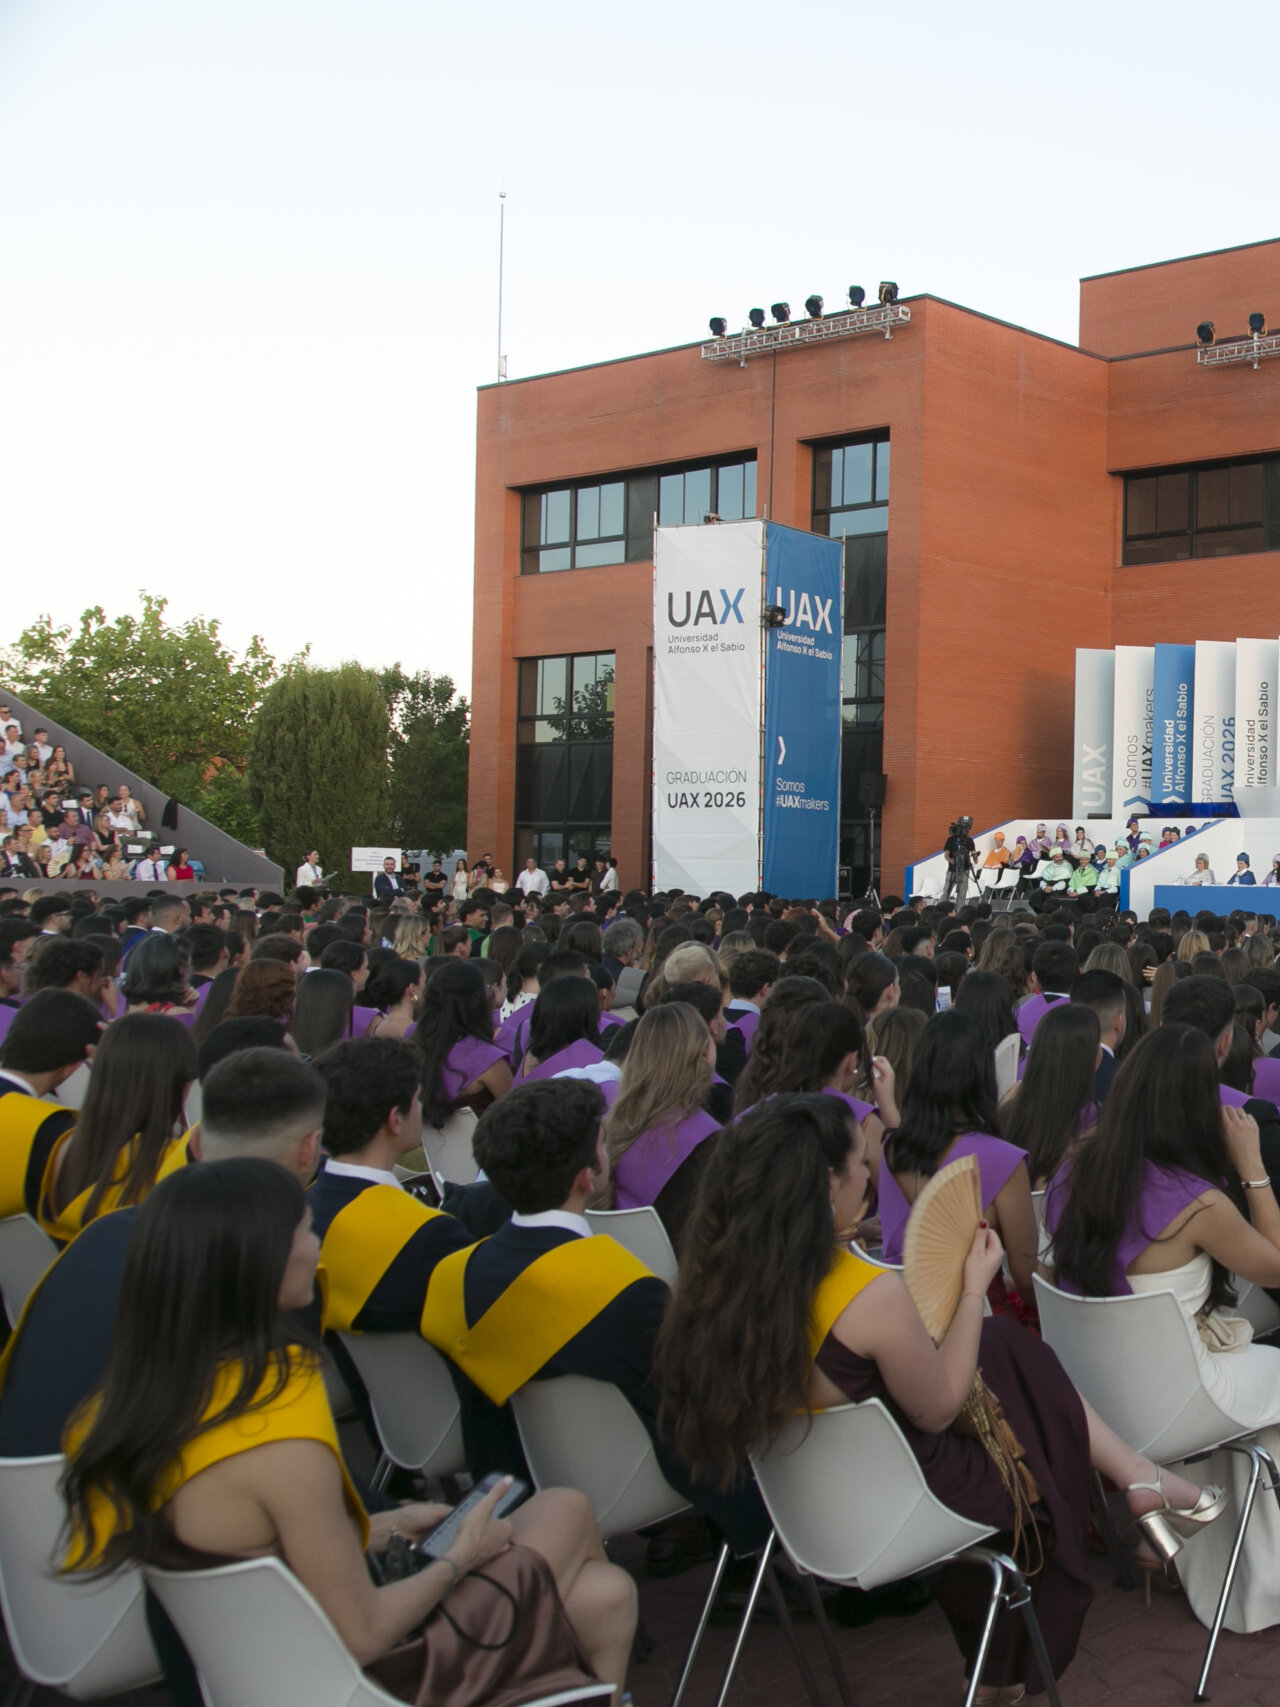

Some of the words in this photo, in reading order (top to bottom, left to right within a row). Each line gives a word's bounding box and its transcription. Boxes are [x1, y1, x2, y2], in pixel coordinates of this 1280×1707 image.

[668, 588, 745, 628] UAX
[776, 586, 833, 634] UAX
[667, 632, 719, 643] Universidad
[668, 645, 700, 654] Alfonso
[702, 644, 709, 653] X
[710, 643, 719, 652] el
[720, 642, 745, 652] Sabio
[776, 629, 815, 646] Universidad
[776, 640, 802, 654] Alfonso
[802, 646, 808, 655] X
[808, 647, 815, 657] el
[814, 648, 833, 660] Sabio
[1176, 682, 1188, 718] Sabio
[1258, 681, 1269, 717] Sabio
[1141, 688, 1154, 790] #UAXmakers
[1176, 720, 1187, 731] el
[1176, 734, 1187, 743] X
[1258, 719, 1268, 731] el
[1258, 733, 1268, 743] X
[1222, 716, 1236, 764] 2026
[1245, 719, 1256, 787] niversidad
[1123, 734, 1138, 789] Somos
[1162, 719, 1175, 792] Universidad
[1175, 745, 1186, 793] Alfonso
[1257, 745, 1268, 786] lfonso
[666, 767, 747, 784] GRADUACIÓN
[776, 777, 805, 793] Somos
[1081, 743, 1107, 807] UAX
[668, 792, 700, 808] UAX
[704, 791, 746, 808] 2026
[776, 794, 829, 811] #UAXmakers
